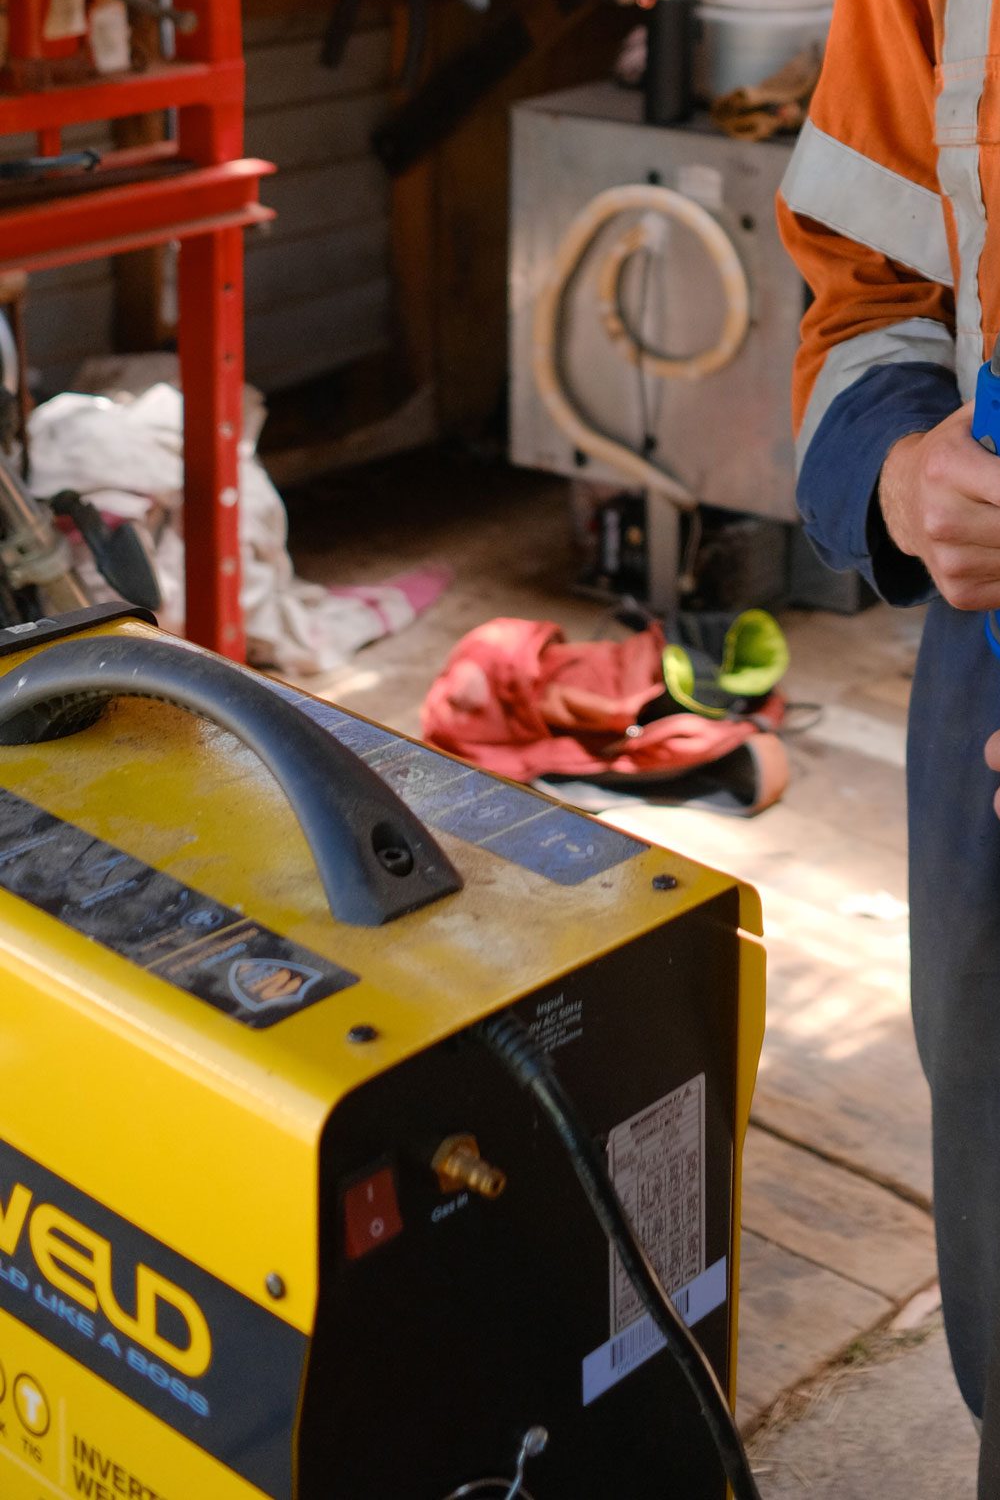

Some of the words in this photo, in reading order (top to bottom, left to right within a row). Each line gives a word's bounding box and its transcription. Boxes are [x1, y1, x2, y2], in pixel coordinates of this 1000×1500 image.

[34, 1283, 96, 1339] LIKE
[99, 1331, 122, 1358] A
[127, 1346, 211, 1418] BOSS
[21, 1437, 43, 1465] TIG
